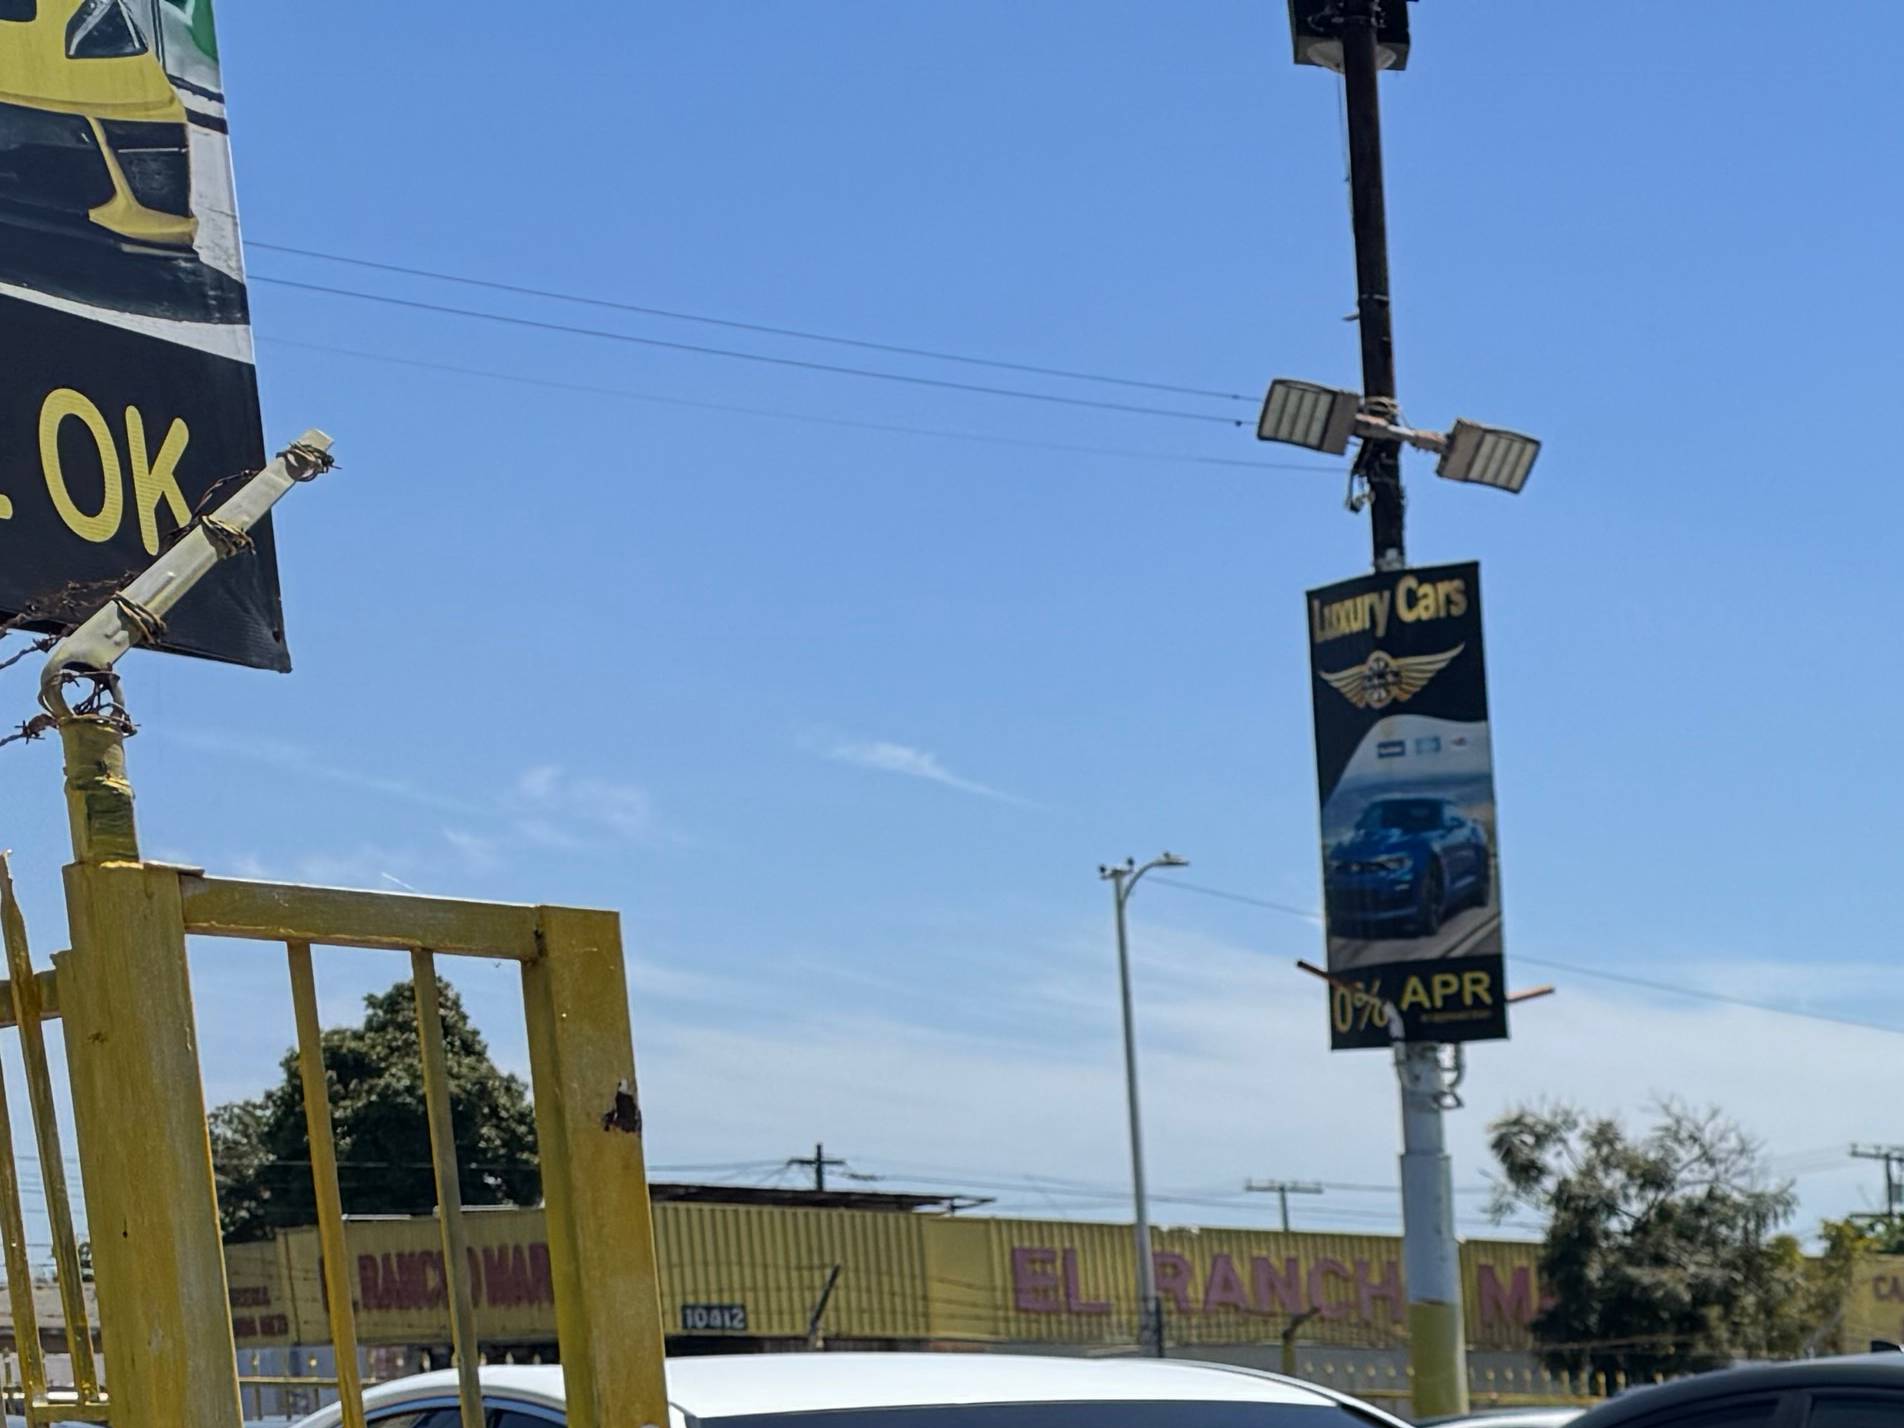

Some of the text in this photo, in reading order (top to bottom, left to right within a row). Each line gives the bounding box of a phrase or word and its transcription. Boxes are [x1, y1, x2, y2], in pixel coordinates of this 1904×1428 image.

[38, 387, 193, 555] OK
[1313, 574, 1467, 645] Luxury Cars
[1400, 970, 1494, 1012] APR
[686, 1306, 745, 1329] 10412
[1012, 1246, 1112, 1315] EL
[1152, 1250, 1404, 1324] RANCH
